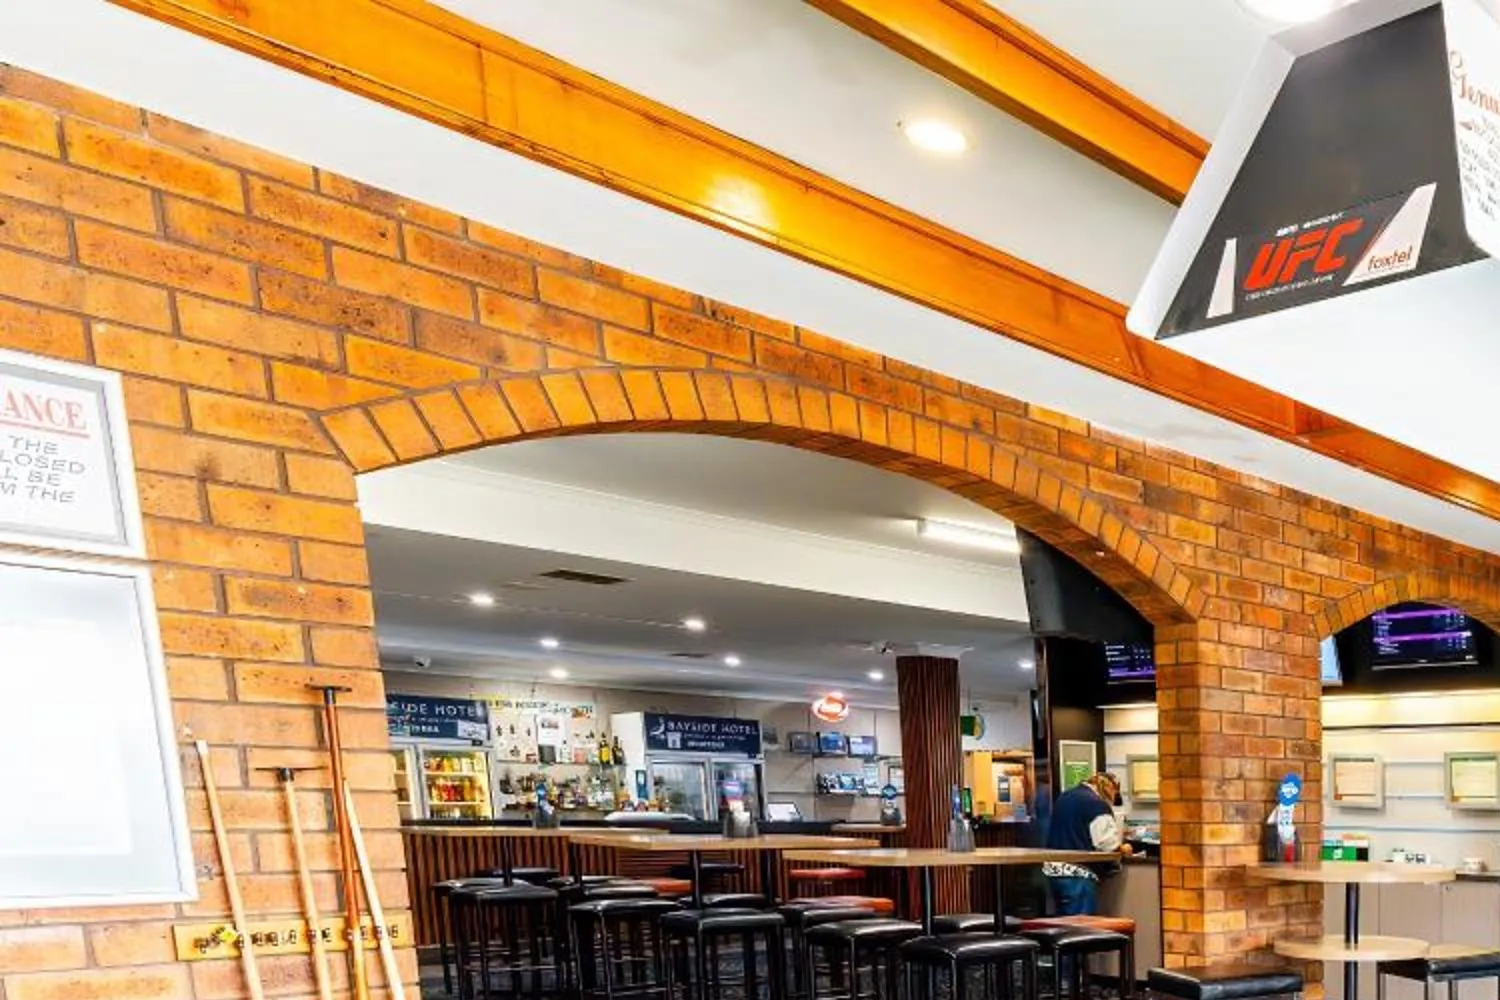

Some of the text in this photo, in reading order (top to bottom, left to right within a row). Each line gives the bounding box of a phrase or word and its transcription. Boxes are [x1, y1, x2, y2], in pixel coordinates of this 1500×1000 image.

[1243, 217, 1364, 290] UFC
[1367, 245, 1414, 271] foxtel
[8, 434, 59, 455] THE
[27, 470, 61, 487] BE
[26, 484, 76, 503] THE
